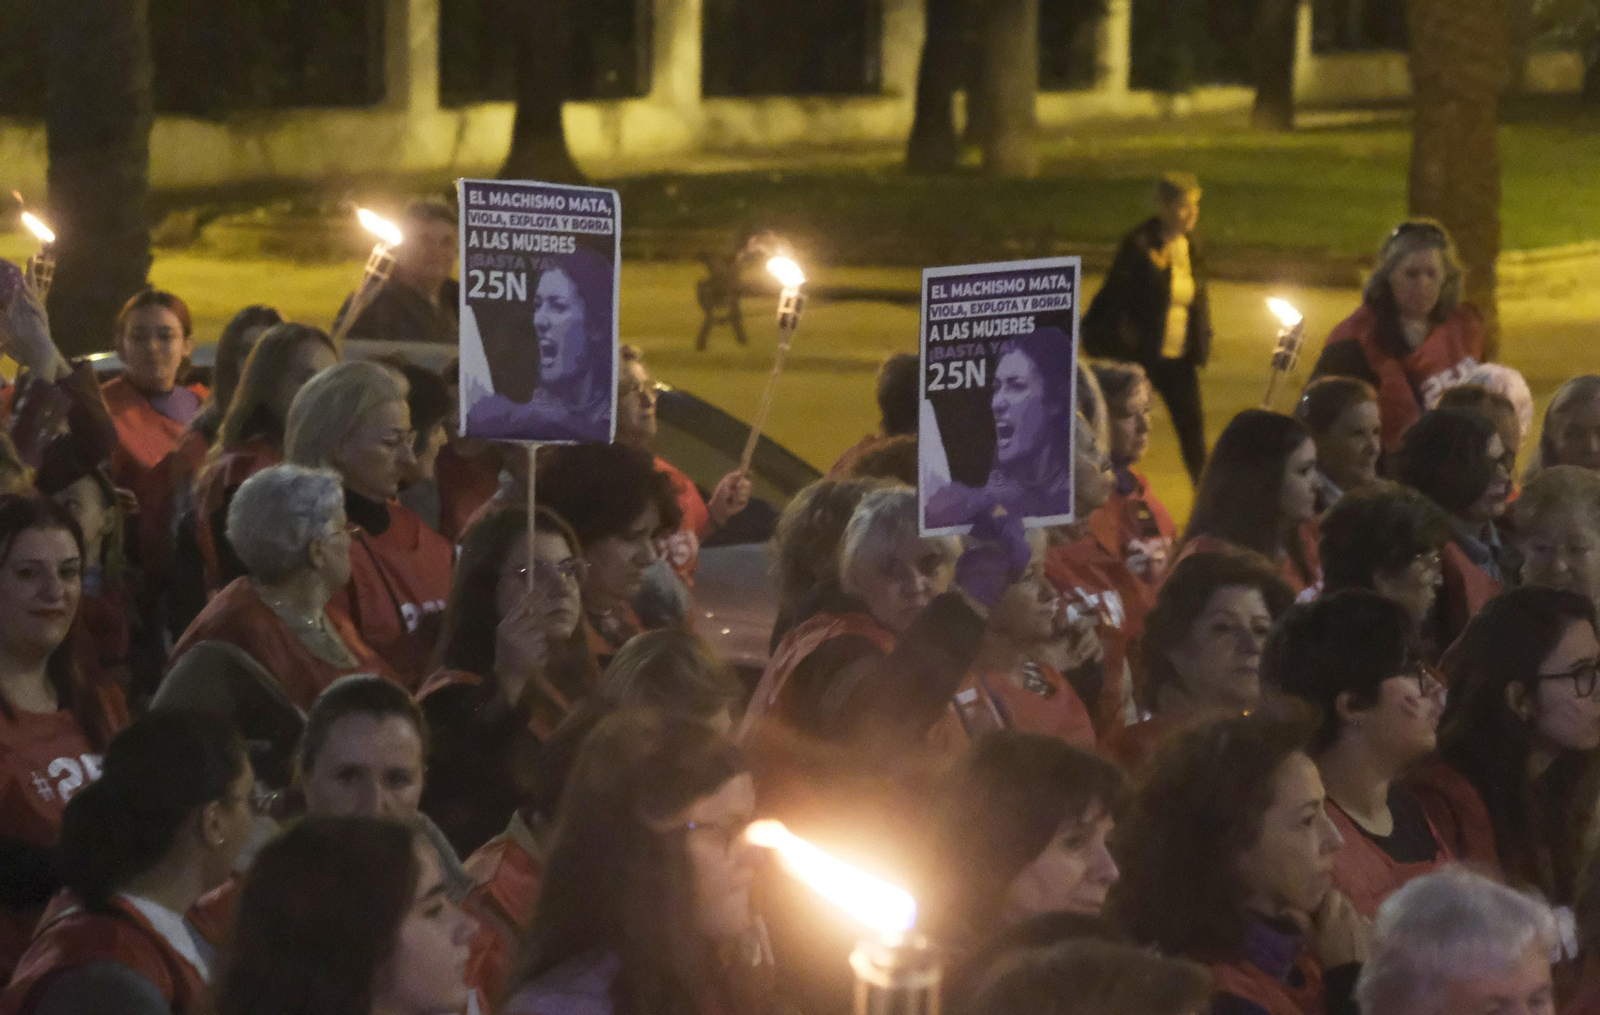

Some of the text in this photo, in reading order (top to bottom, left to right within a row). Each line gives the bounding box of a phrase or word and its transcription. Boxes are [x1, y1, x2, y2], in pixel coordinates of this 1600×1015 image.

[469, 190, 612, 216] EL MACHISMO MATA,
[469, 211, 610, 231] VIOLA, EXPLOTA Y BORRA
[469, 230, 576, 254] A LAS MUJERES
[468, 269, 527, 301] 25N
[931, 274, 1071, 299] EL MACHISMO MATA,
[930, 296, 1068, 318] VIOLA, EXPLOTA Y BORRA
[929, 316, 1035, 342] A LAS MUJERES
[928, 358, 986, 391] 25N
